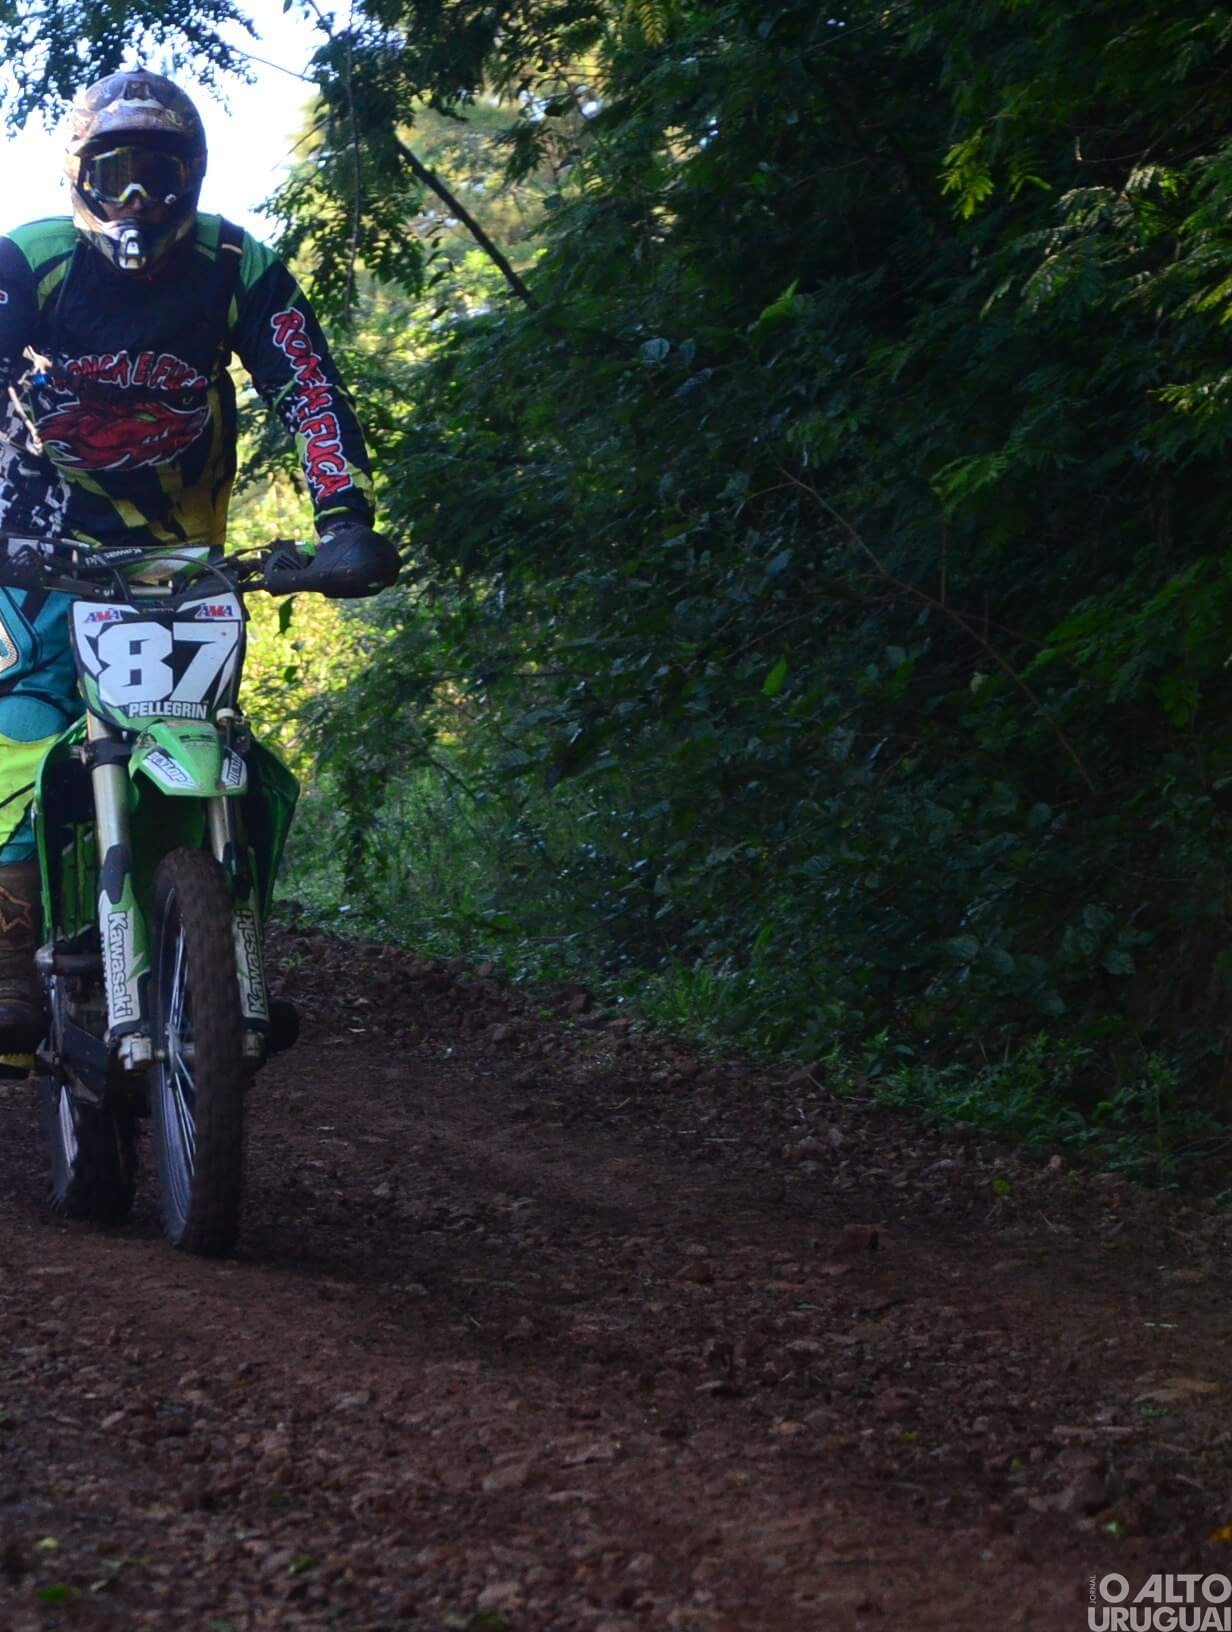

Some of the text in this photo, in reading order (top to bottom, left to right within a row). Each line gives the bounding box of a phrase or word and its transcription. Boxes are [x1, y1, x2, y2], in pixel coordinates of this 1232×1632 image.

[84, 607, 122, 624] AMA
[196, 602, 235, 618] AMA
[98, 621, 239, 707] 87
[128, 701, 208, 720] PELLEGRIN
[108, 911, 132, 1020] Kawasaki
[234, 909, 267, 1015] Kawasaki
